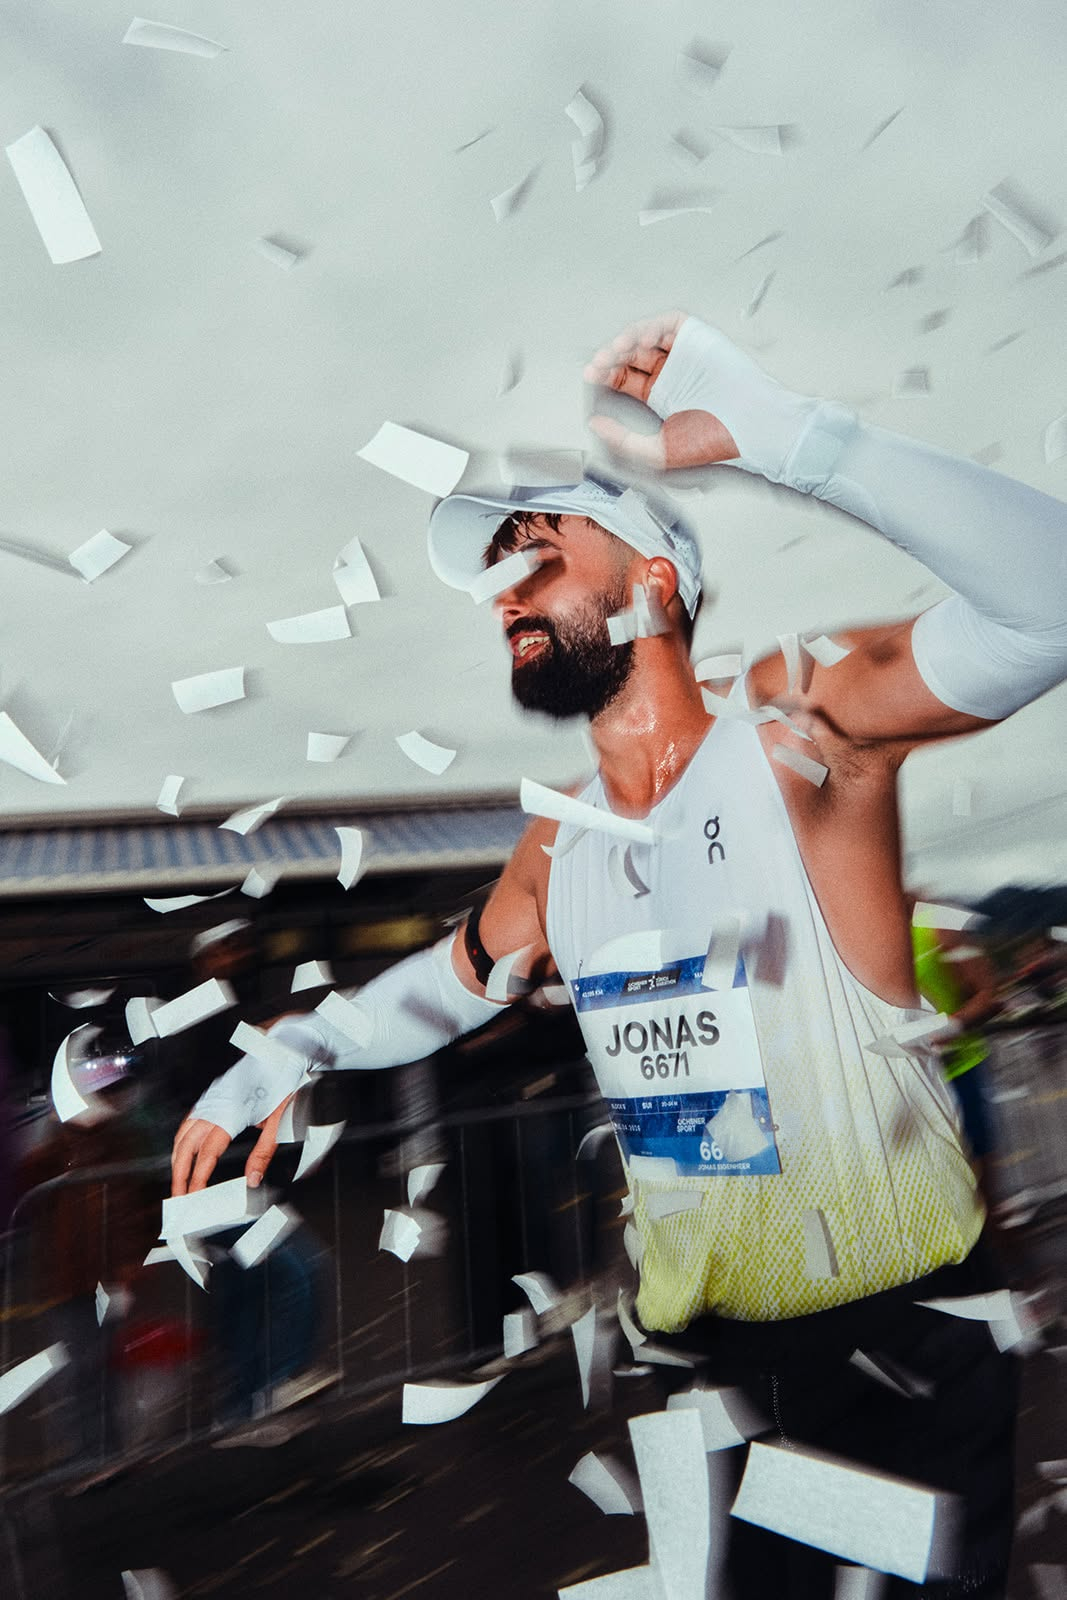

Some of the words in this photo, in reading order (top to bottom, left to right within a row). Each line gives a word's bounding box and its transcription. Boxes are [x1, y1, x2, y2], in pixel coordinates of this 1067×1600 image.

[605, 1010, 720, 1057] JONAS
[640, 1051, 690, 1080] 6671
[677, 1117, 706, 1125] OCHSNER
[676, 1124, 696, 1133] SPORT
[698, 1163, 716, 1171] JONAS
